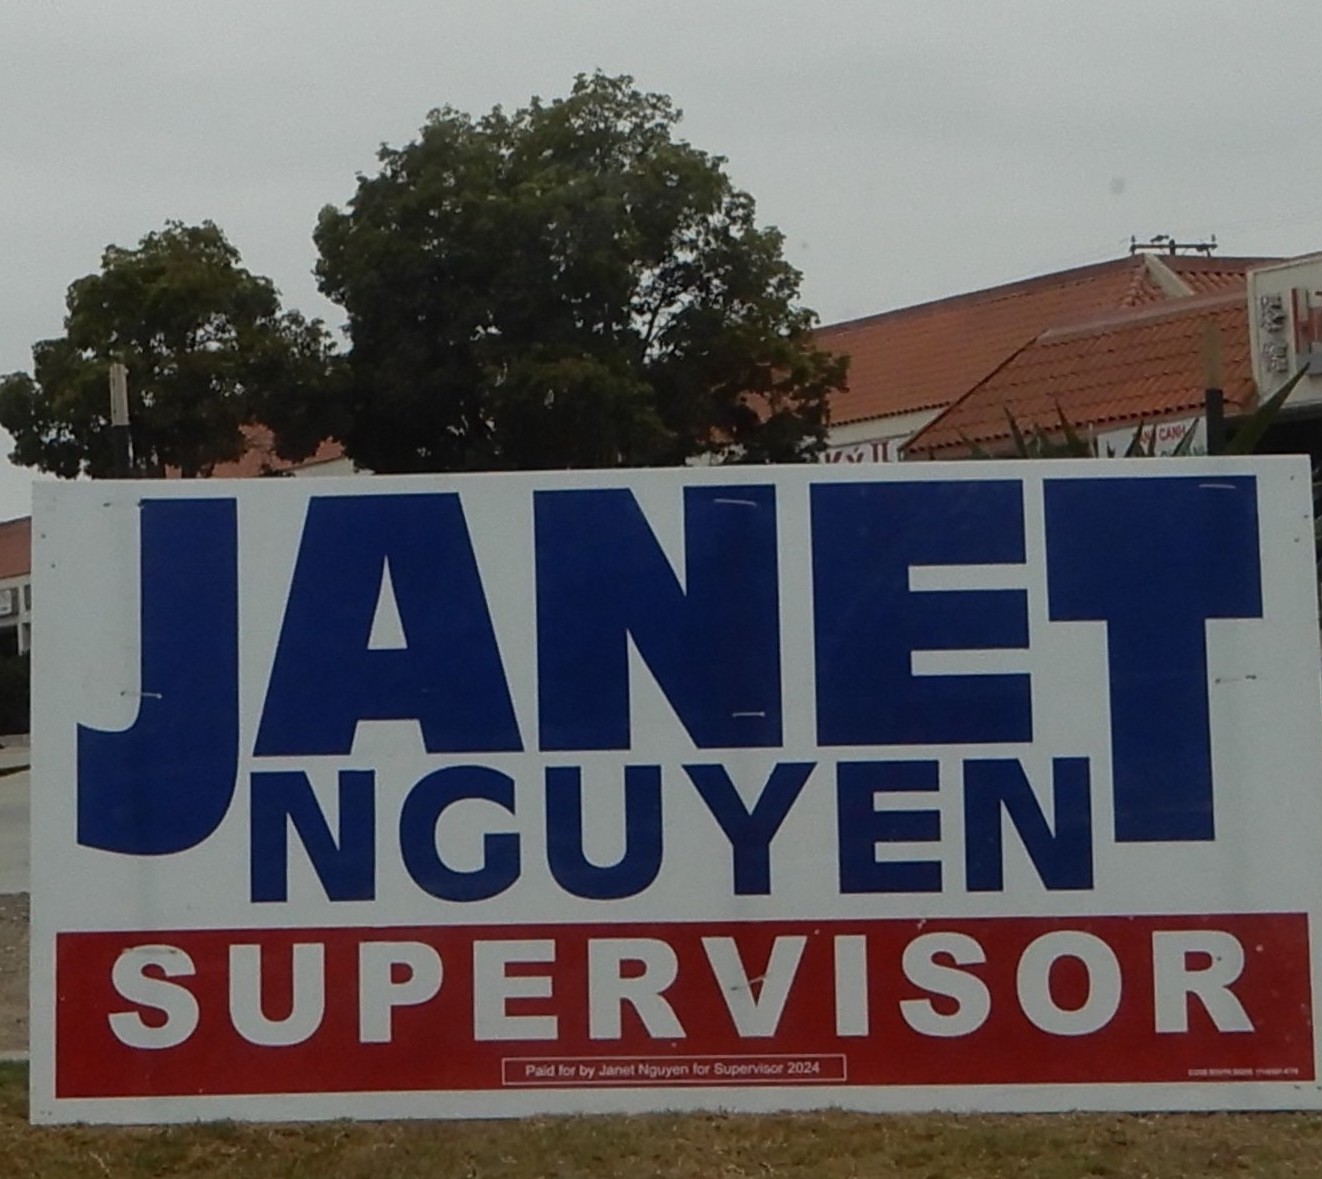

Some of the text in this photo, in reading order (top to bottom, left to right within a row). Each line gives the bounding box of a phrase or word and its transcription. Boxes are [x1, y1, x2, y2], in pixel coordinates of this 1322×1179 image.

[77, 475, 1263, 856] JANET
[250, 756, 1094, 902] NGUYEN
[109, 930, 1255, 1048] SUPERVISOR
[525, 1061, 820, 1079] Paid for by Janet Nguyen for Supervisor 2024
